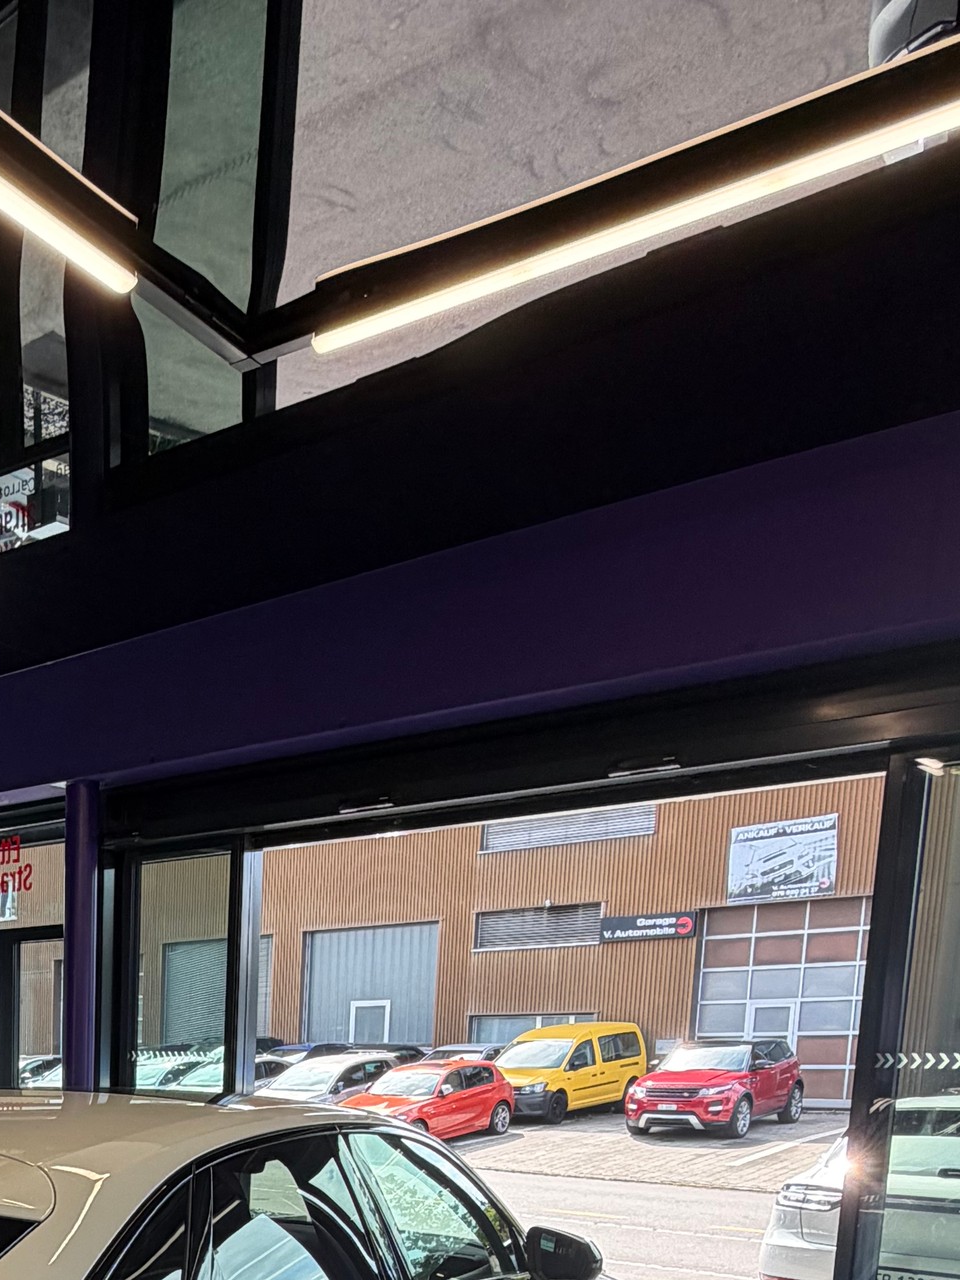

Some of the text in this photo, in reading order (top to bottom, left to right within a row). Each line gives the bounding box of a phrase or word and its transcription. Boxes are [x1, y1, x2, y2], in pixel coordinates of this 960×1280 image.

[737, 819, 835, 841] ANKAUF VERKAUF
[636, 917, 677, 927] Garage
[603, 927, 676, 939] V. Automobile
